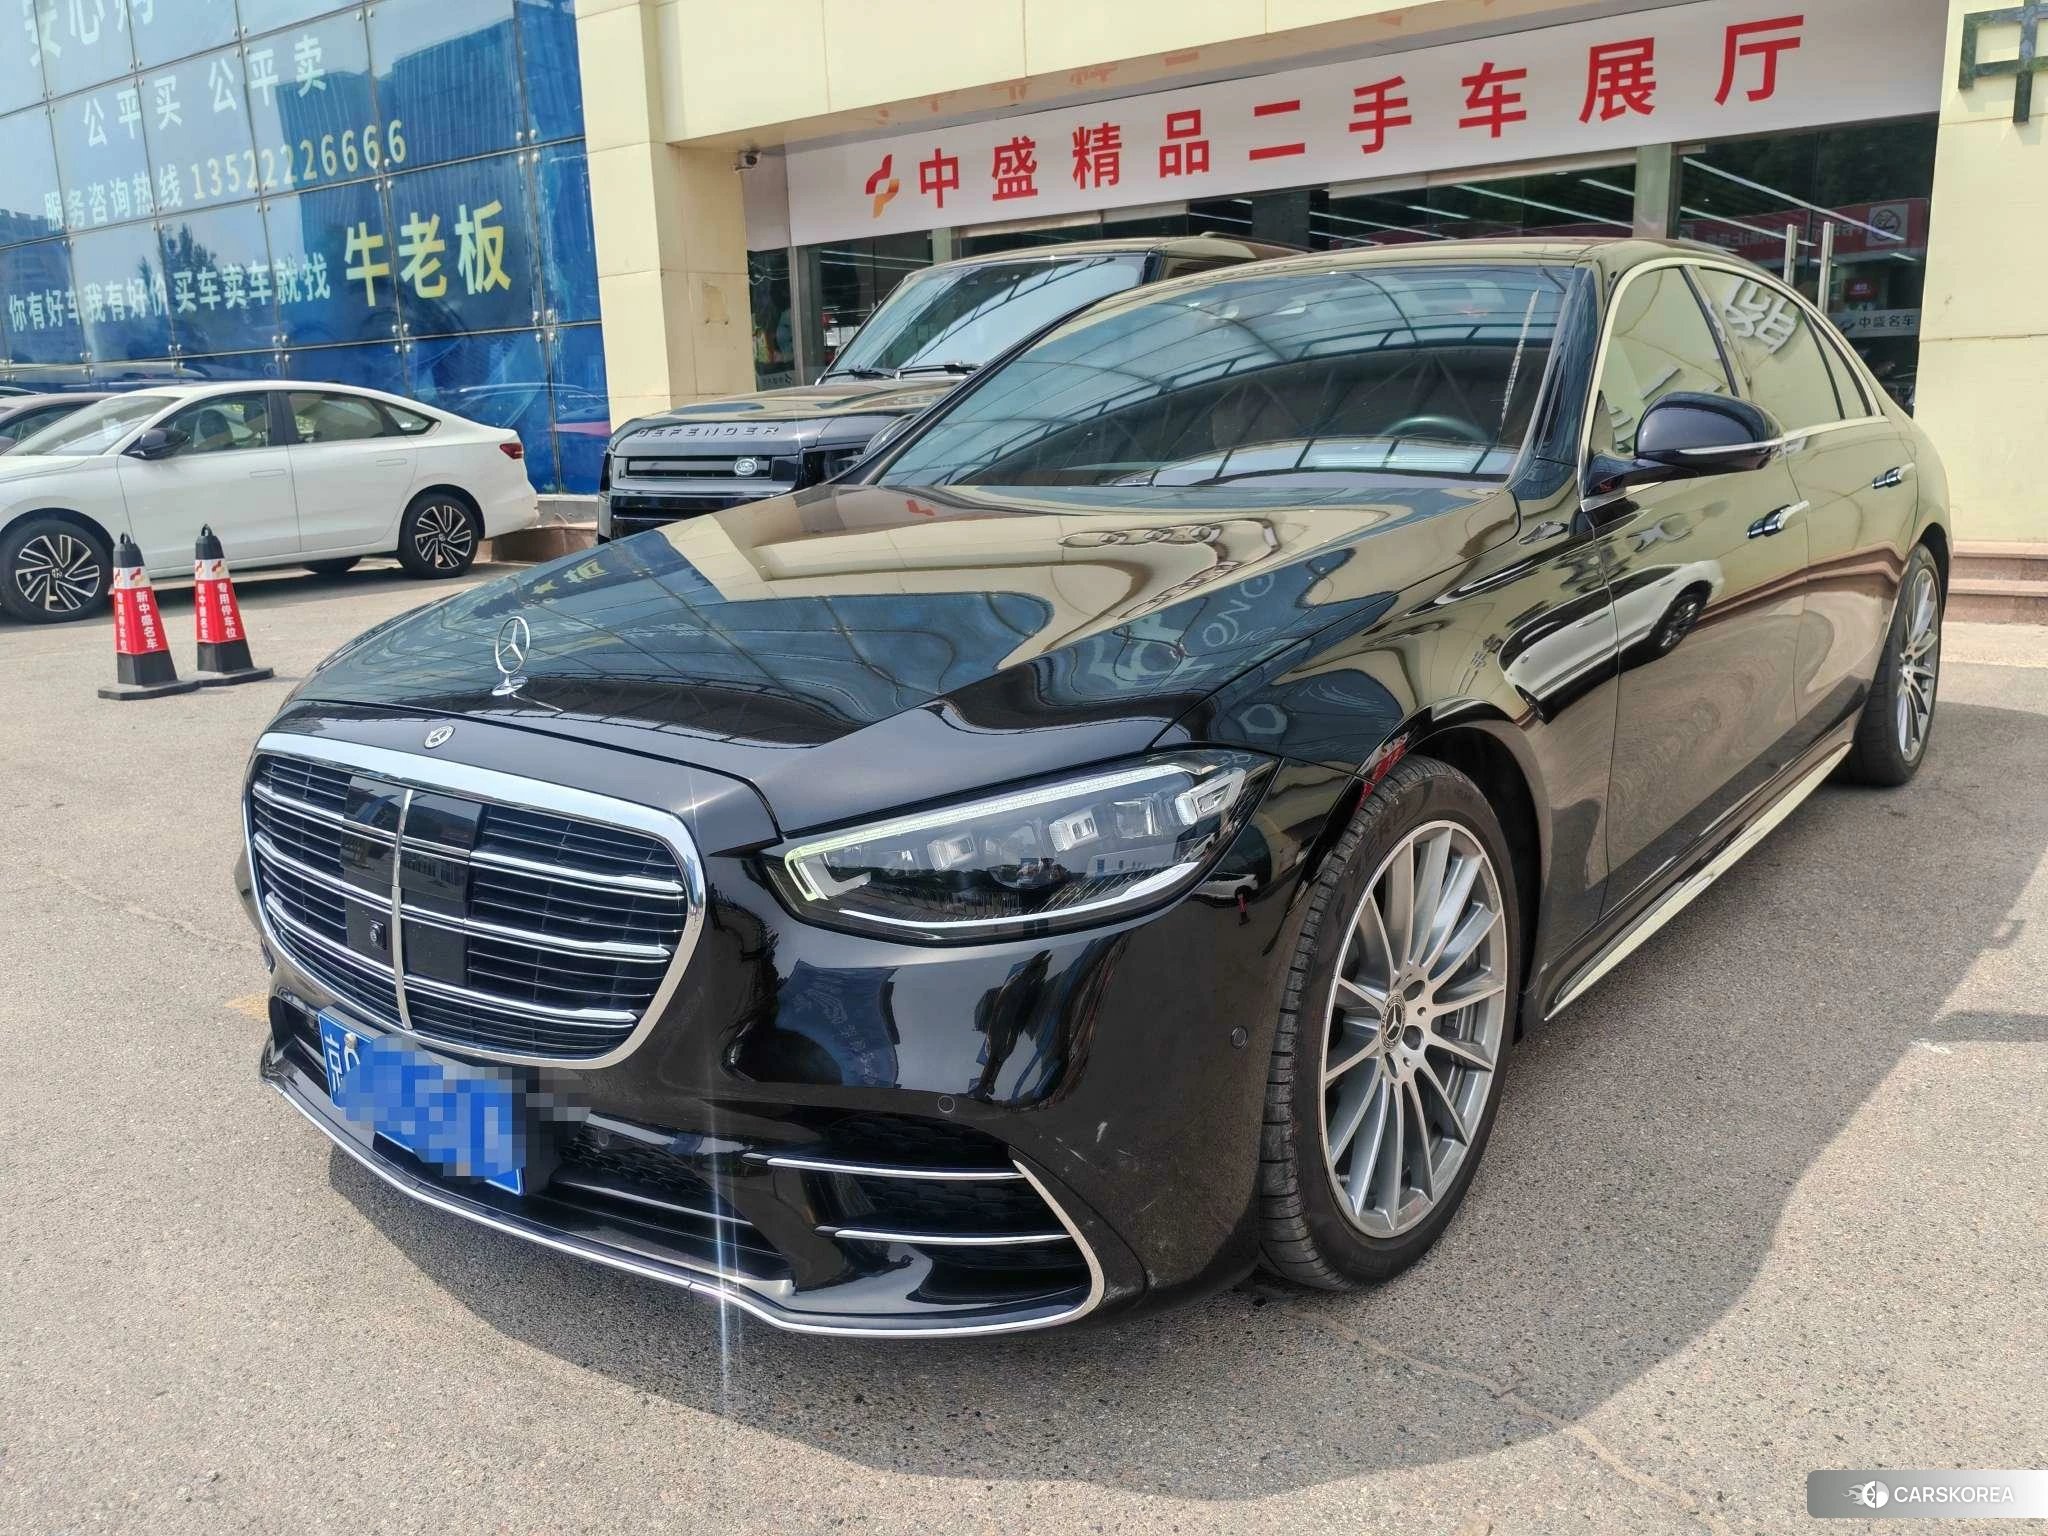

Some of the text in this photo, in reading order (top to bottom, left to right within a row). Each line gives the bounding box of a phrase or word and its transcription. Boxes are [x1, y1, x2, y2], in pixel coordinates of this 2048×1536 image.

[83, 34, 327, 147] 公平买 公平卖
[919, 15, 1805, 209] 中盛精品二手车展厅
[44, 119, 406, 232] 服务咨询热线 13522226666
[344, 200, 512, 308] 牛老板
[637, 427, 779, 438] DEFENDER
